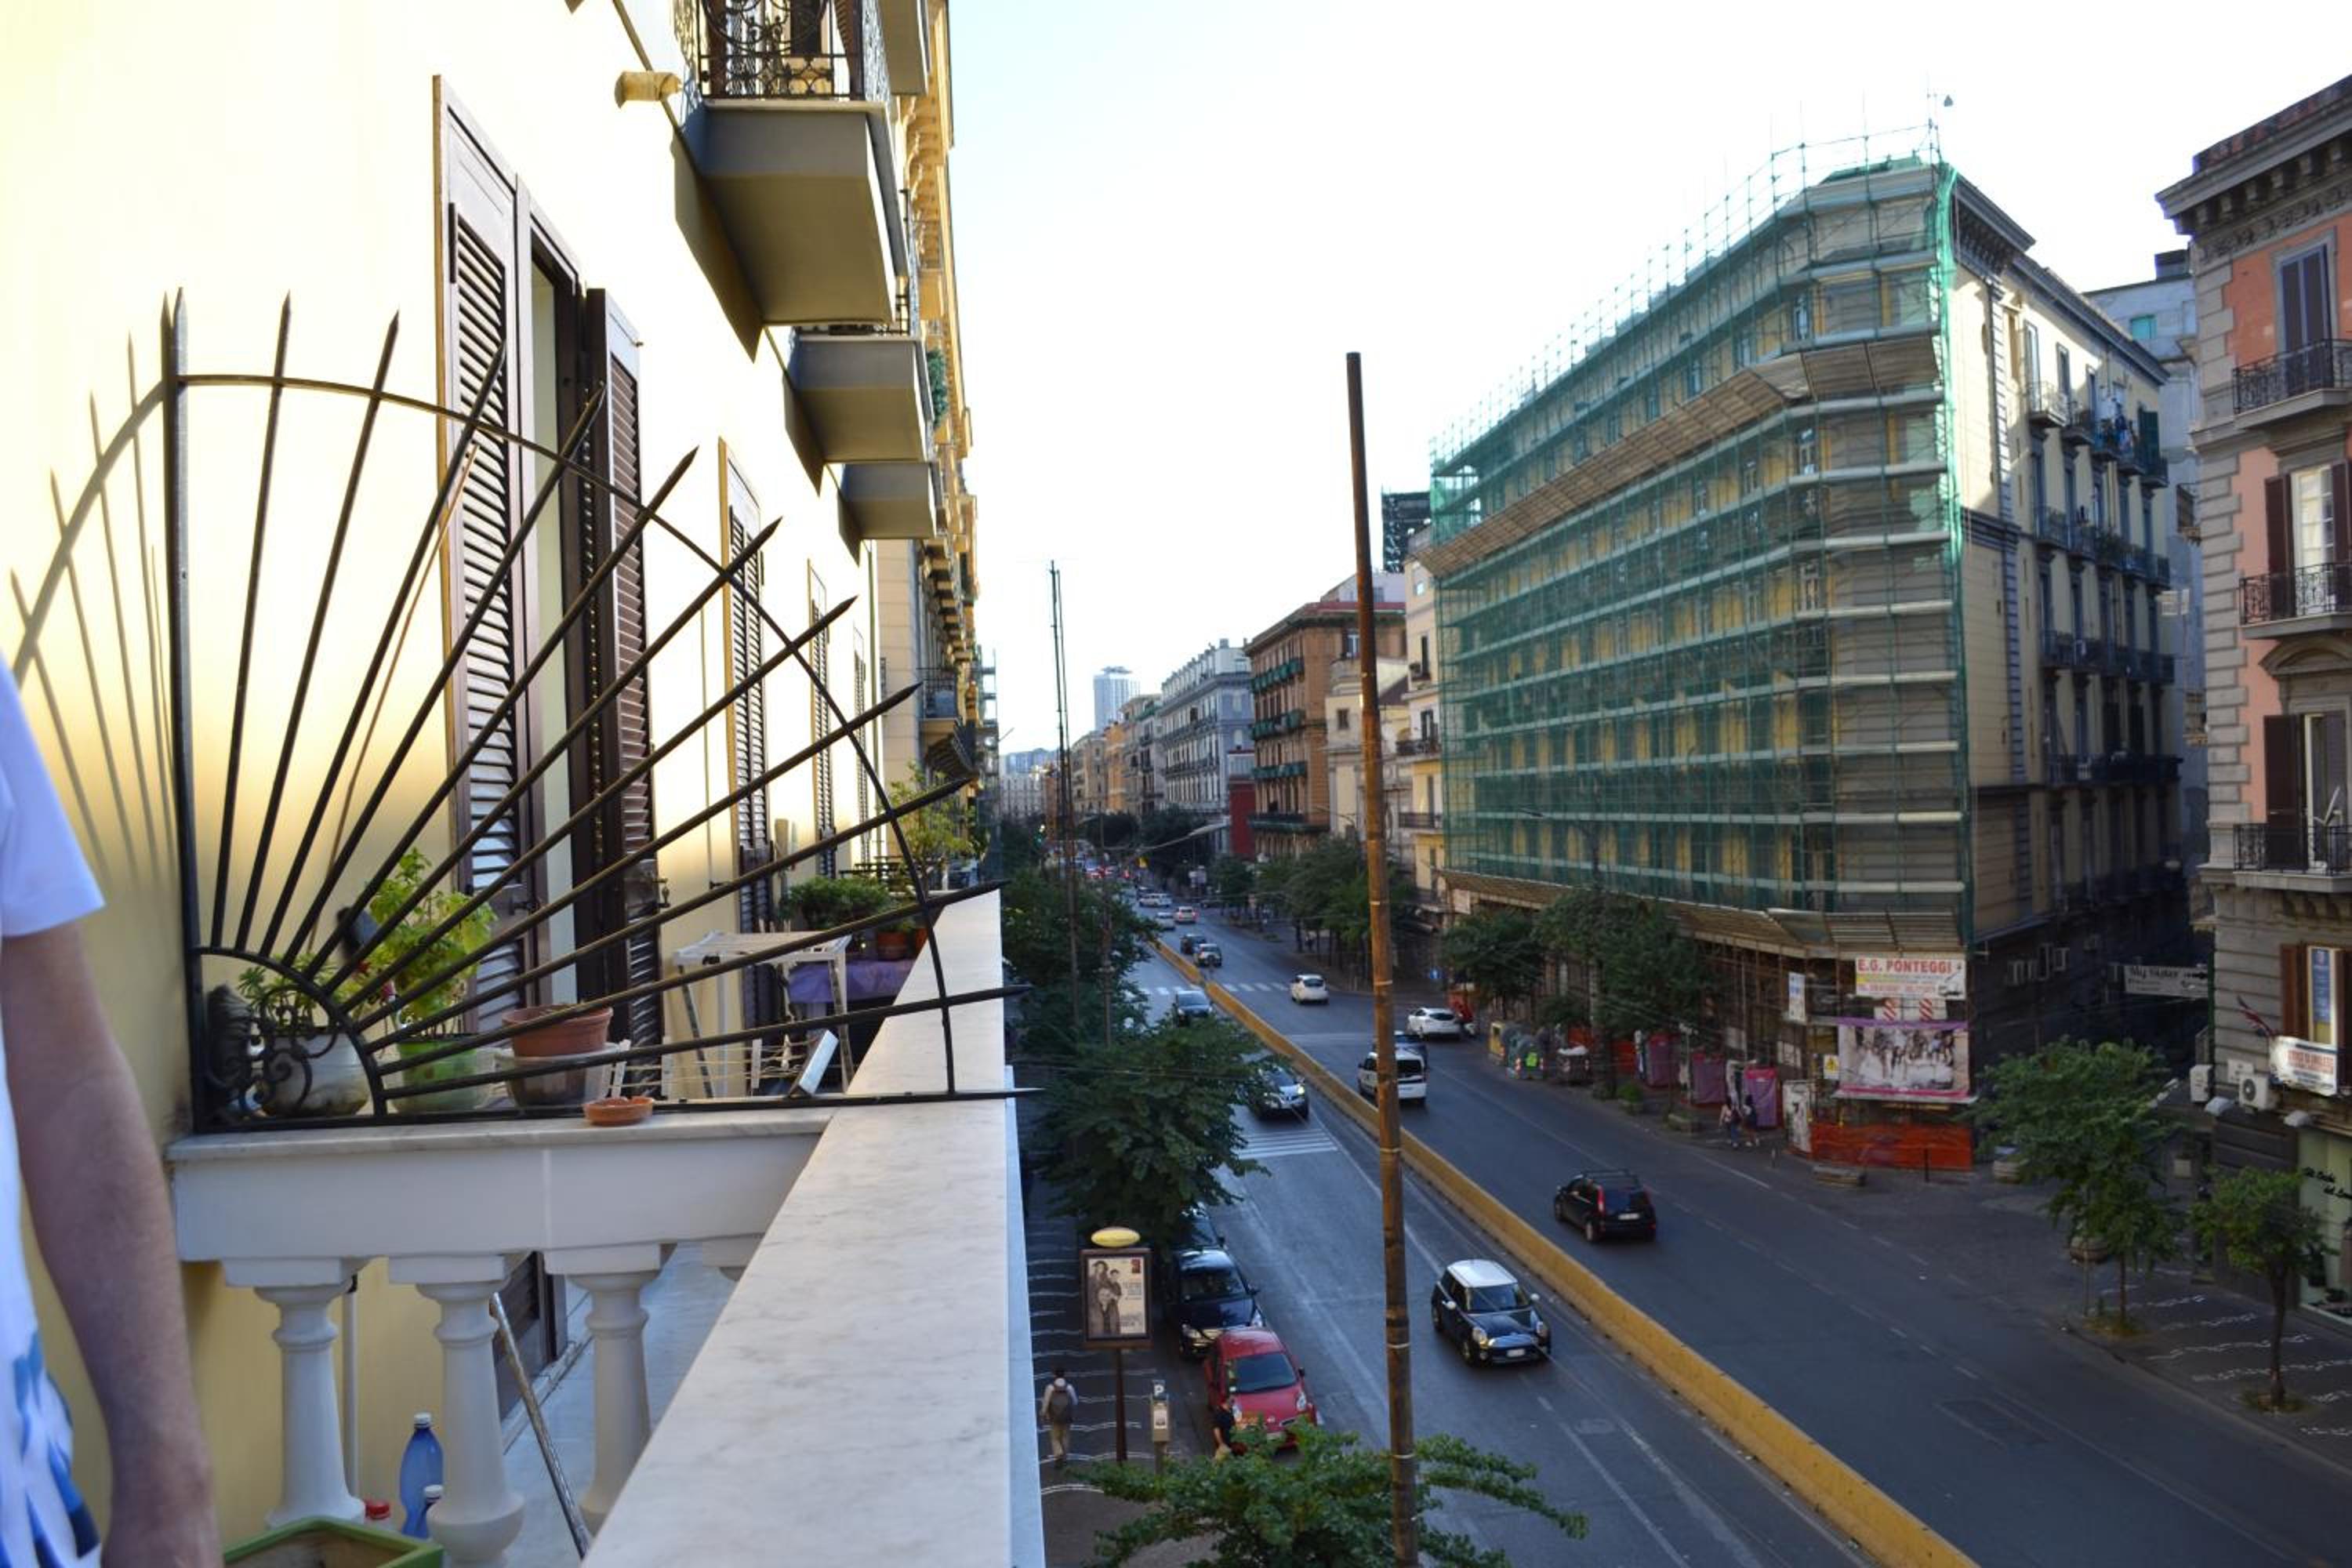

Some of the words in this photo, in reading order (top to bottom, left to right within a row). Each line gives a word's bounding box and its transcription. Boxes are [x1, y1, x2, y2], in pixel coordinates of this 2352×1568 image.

[1857, 958, 1882, 972] E.G.
[1886, 959, 1952, 974] PONTEGGI
[1153, 1385, 1164, 1396] P
